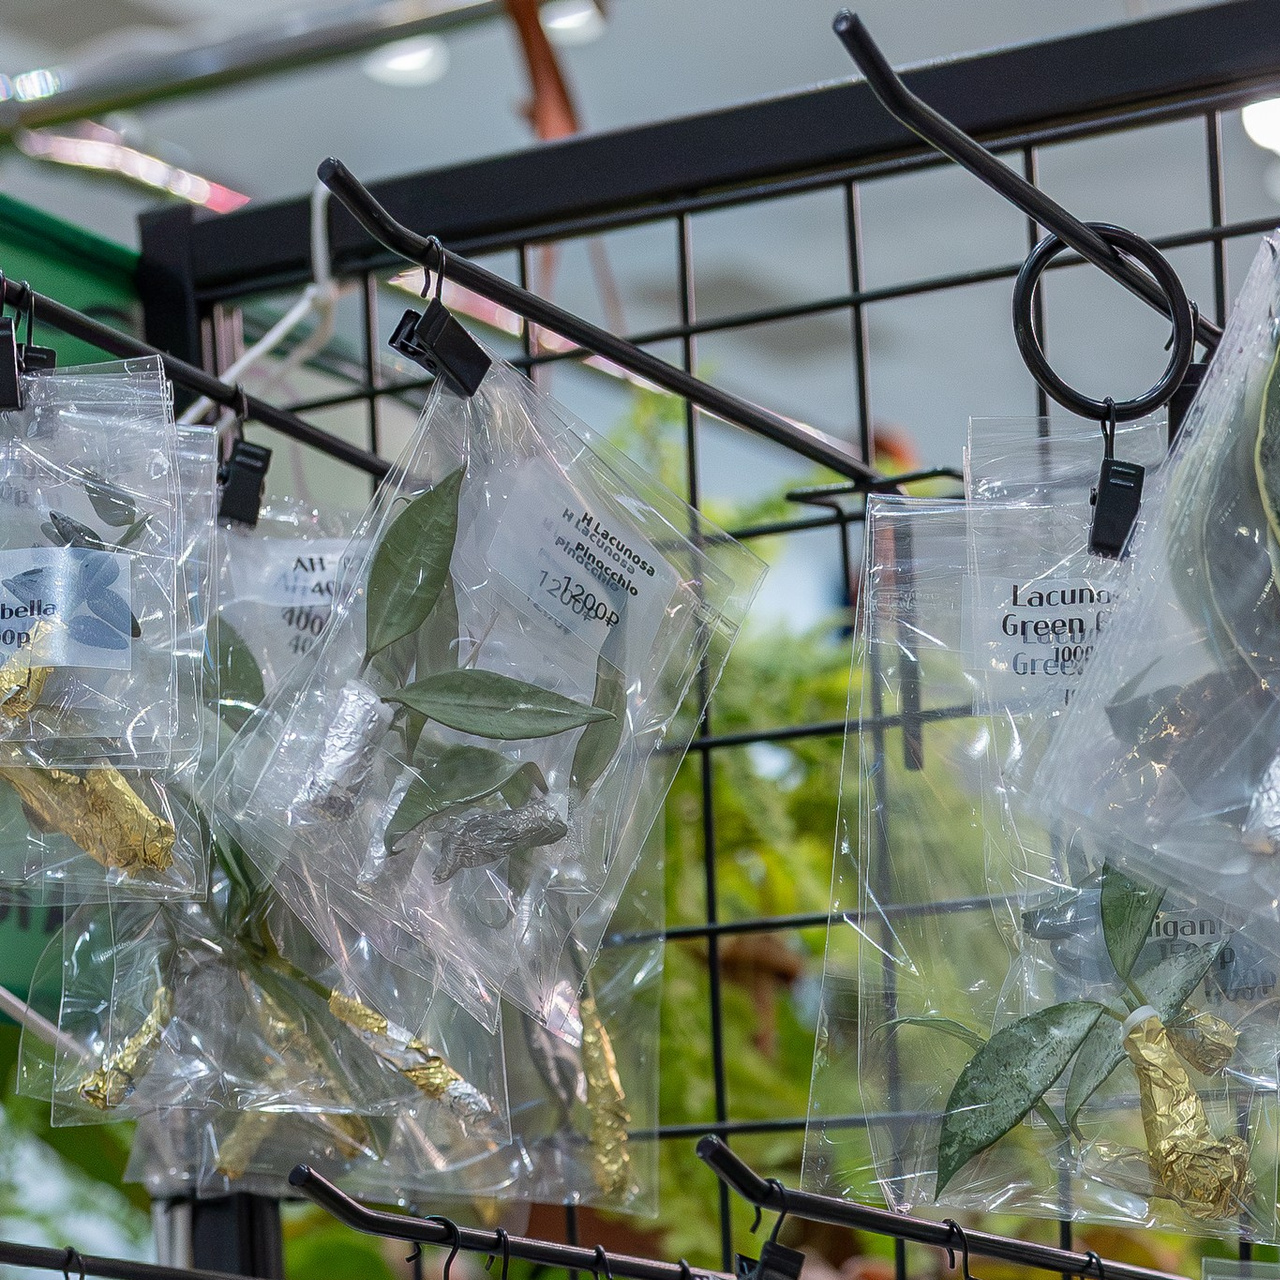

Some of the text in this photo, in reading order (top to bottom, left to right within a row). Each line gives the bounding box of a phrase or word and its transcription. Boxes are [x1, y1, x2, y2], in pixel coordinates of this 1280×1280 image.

[575, 542, 638, 596] Pinocchio
[581, 512, 655, 577] H Lacunosa
[563, 576, 620, 627] 1200₽
[1002, 613, 1084, 637] Green
